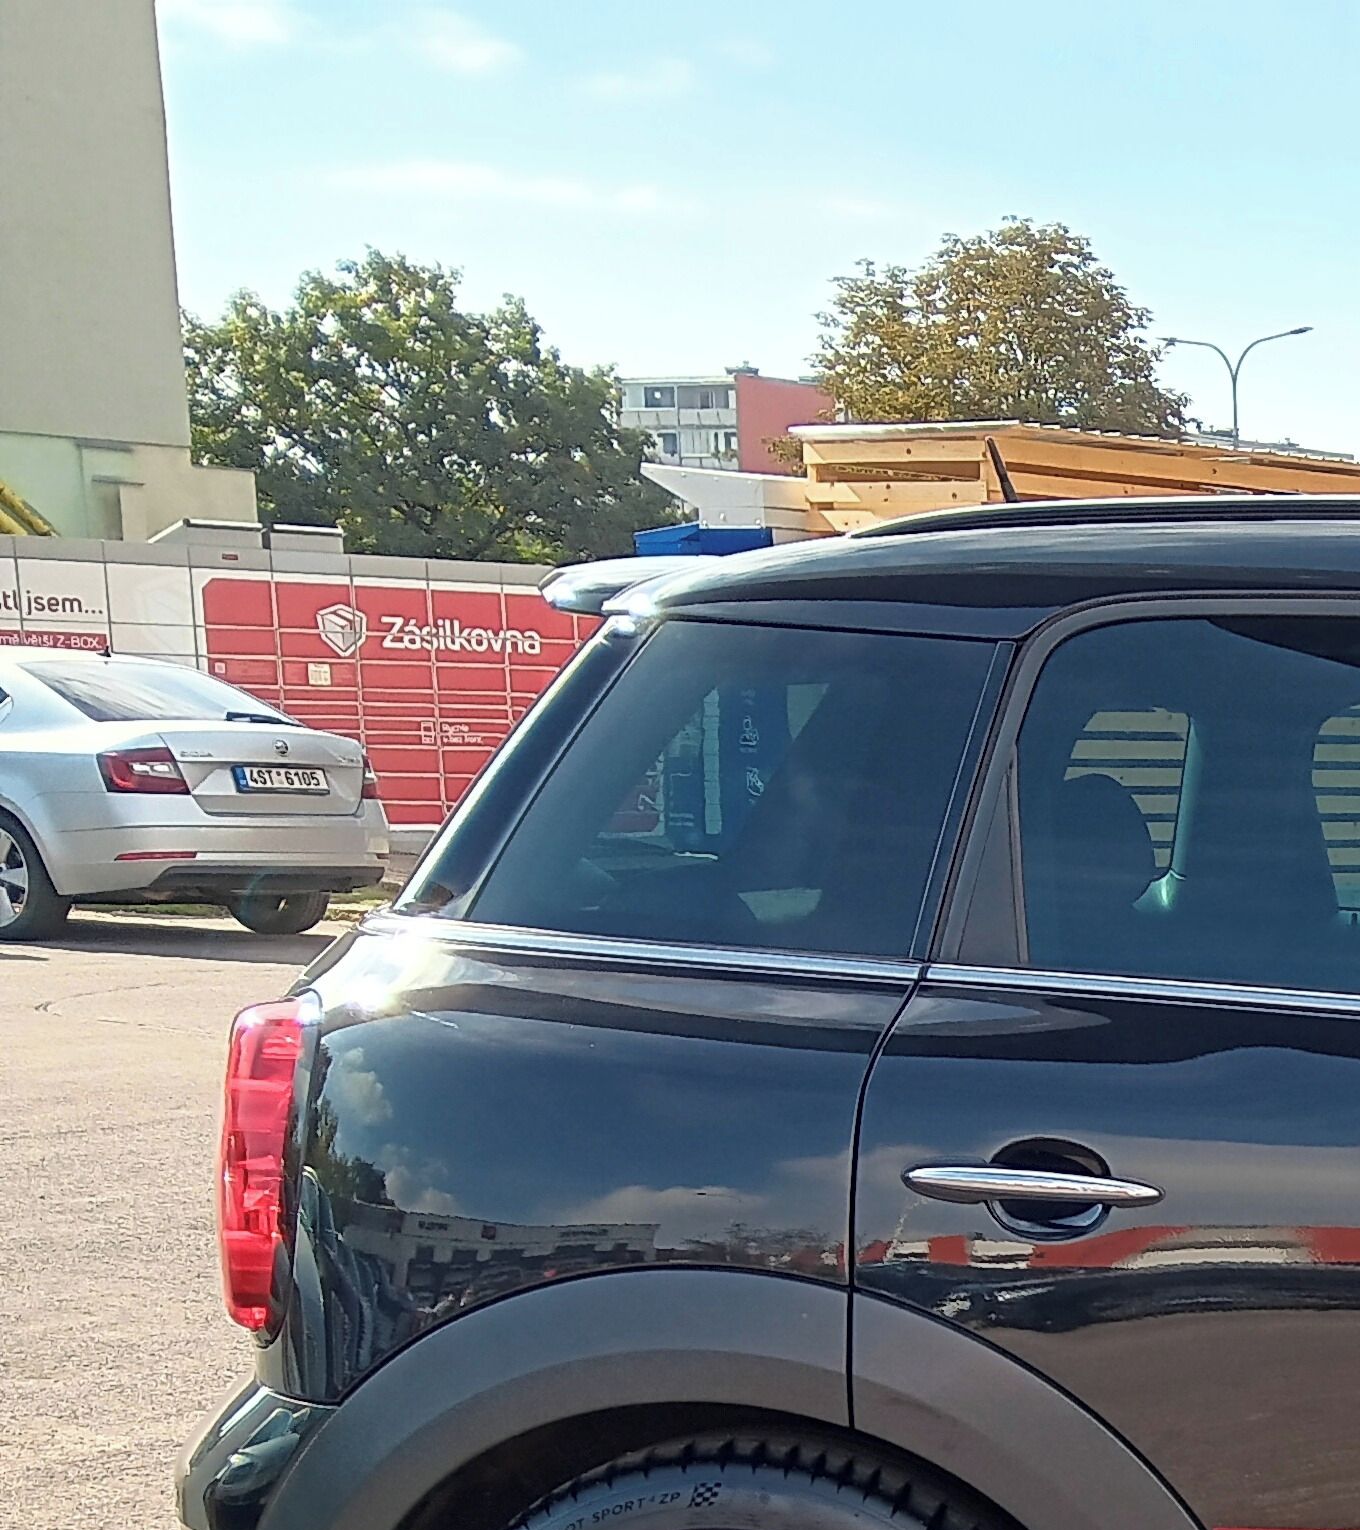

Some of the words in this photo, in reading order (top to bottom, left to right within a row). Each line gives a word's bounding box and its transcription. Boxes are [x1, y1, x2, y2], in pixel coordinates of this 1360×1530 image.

[0, 590, 19, 611] tl
[26, 590, 103, 615] jsem...
[381, 616, 541, 655] Zásilkovna
[250, 769, 274, 785] 4ST
[285, 771, 320, 786] 6105
[592, 1498, 646, 1523] SPORT
[658, 1491, 681, 1505] ZP
